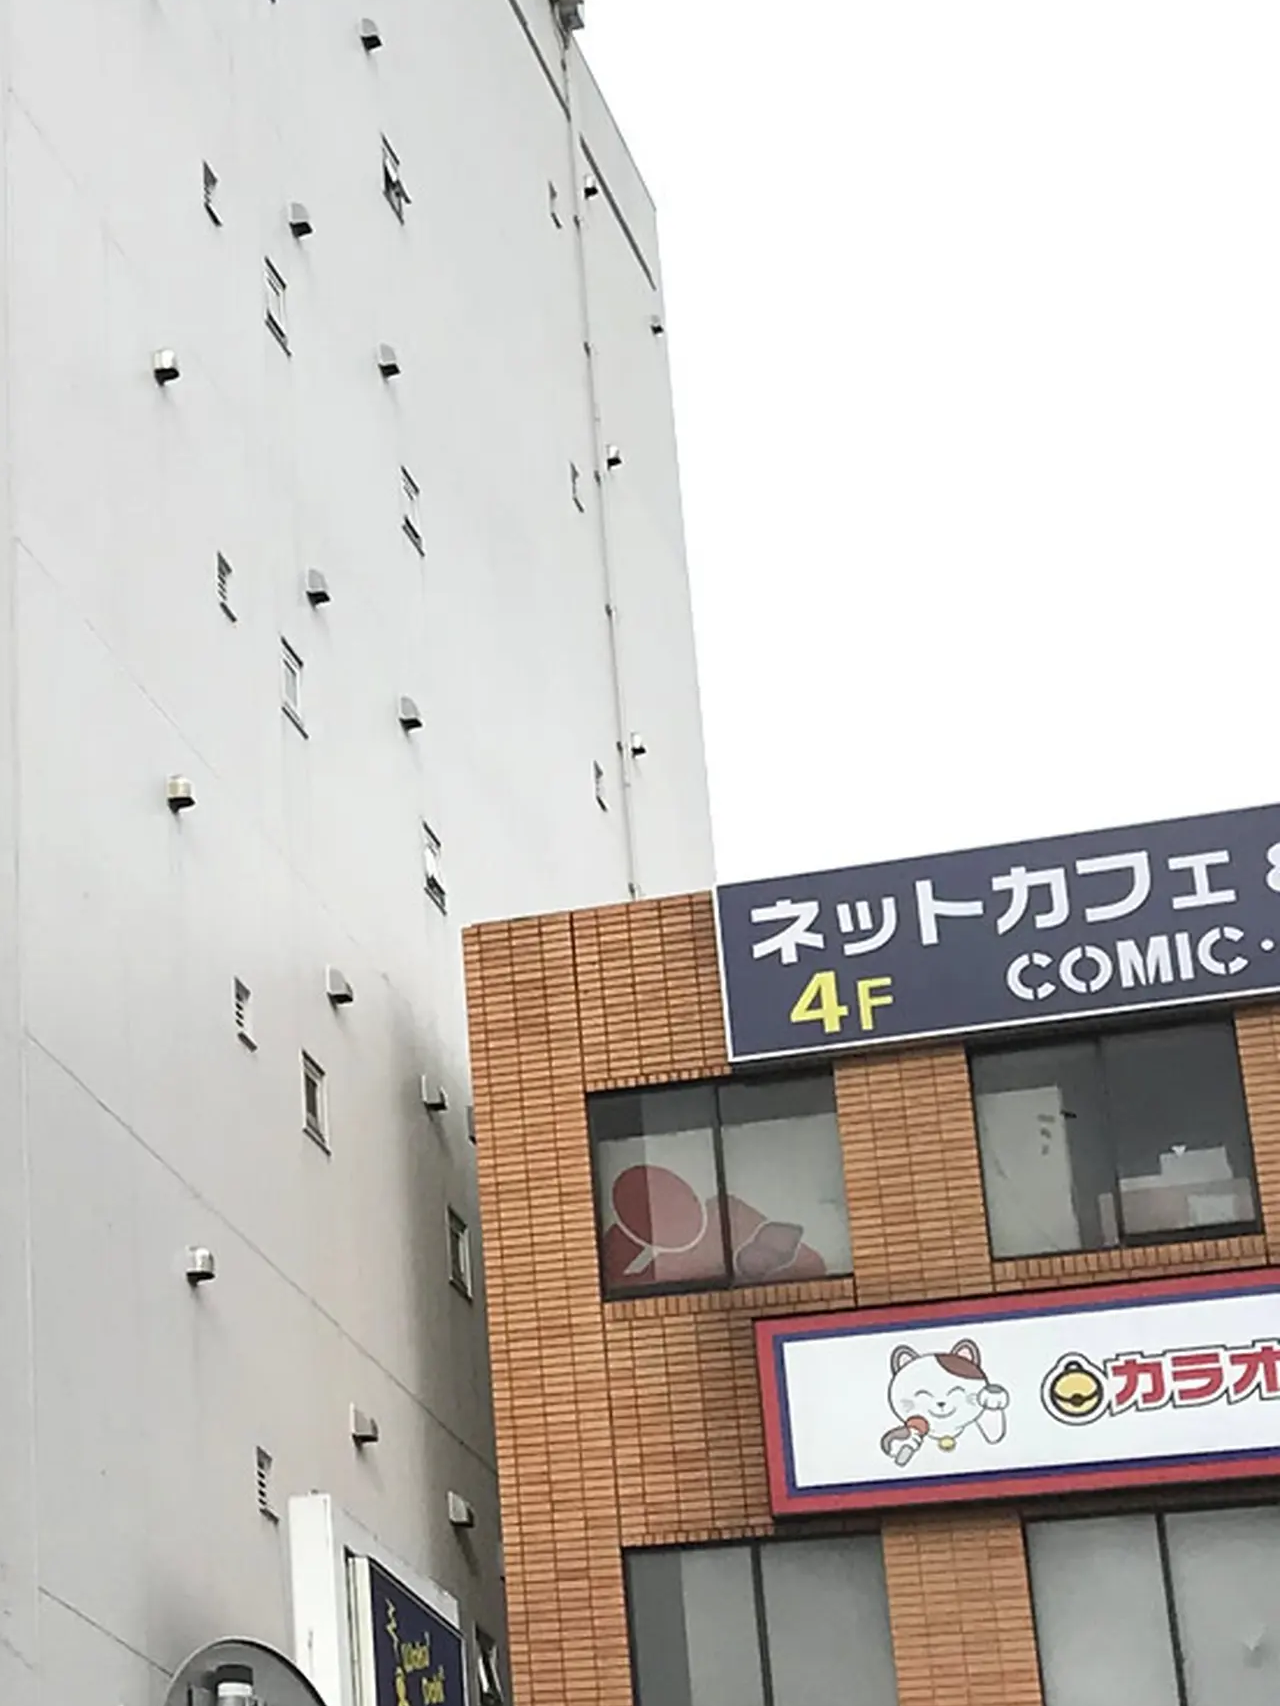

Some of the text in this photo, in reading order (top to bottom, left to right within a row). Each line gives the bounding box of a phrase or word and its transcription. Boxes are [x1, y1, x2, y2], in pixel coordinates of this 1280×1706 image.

[749, 848, 1237, 965] ネットカフェ
[789, 968, 894, 1034] 4F
[1006, 925, 1250, 1001] COMIC
